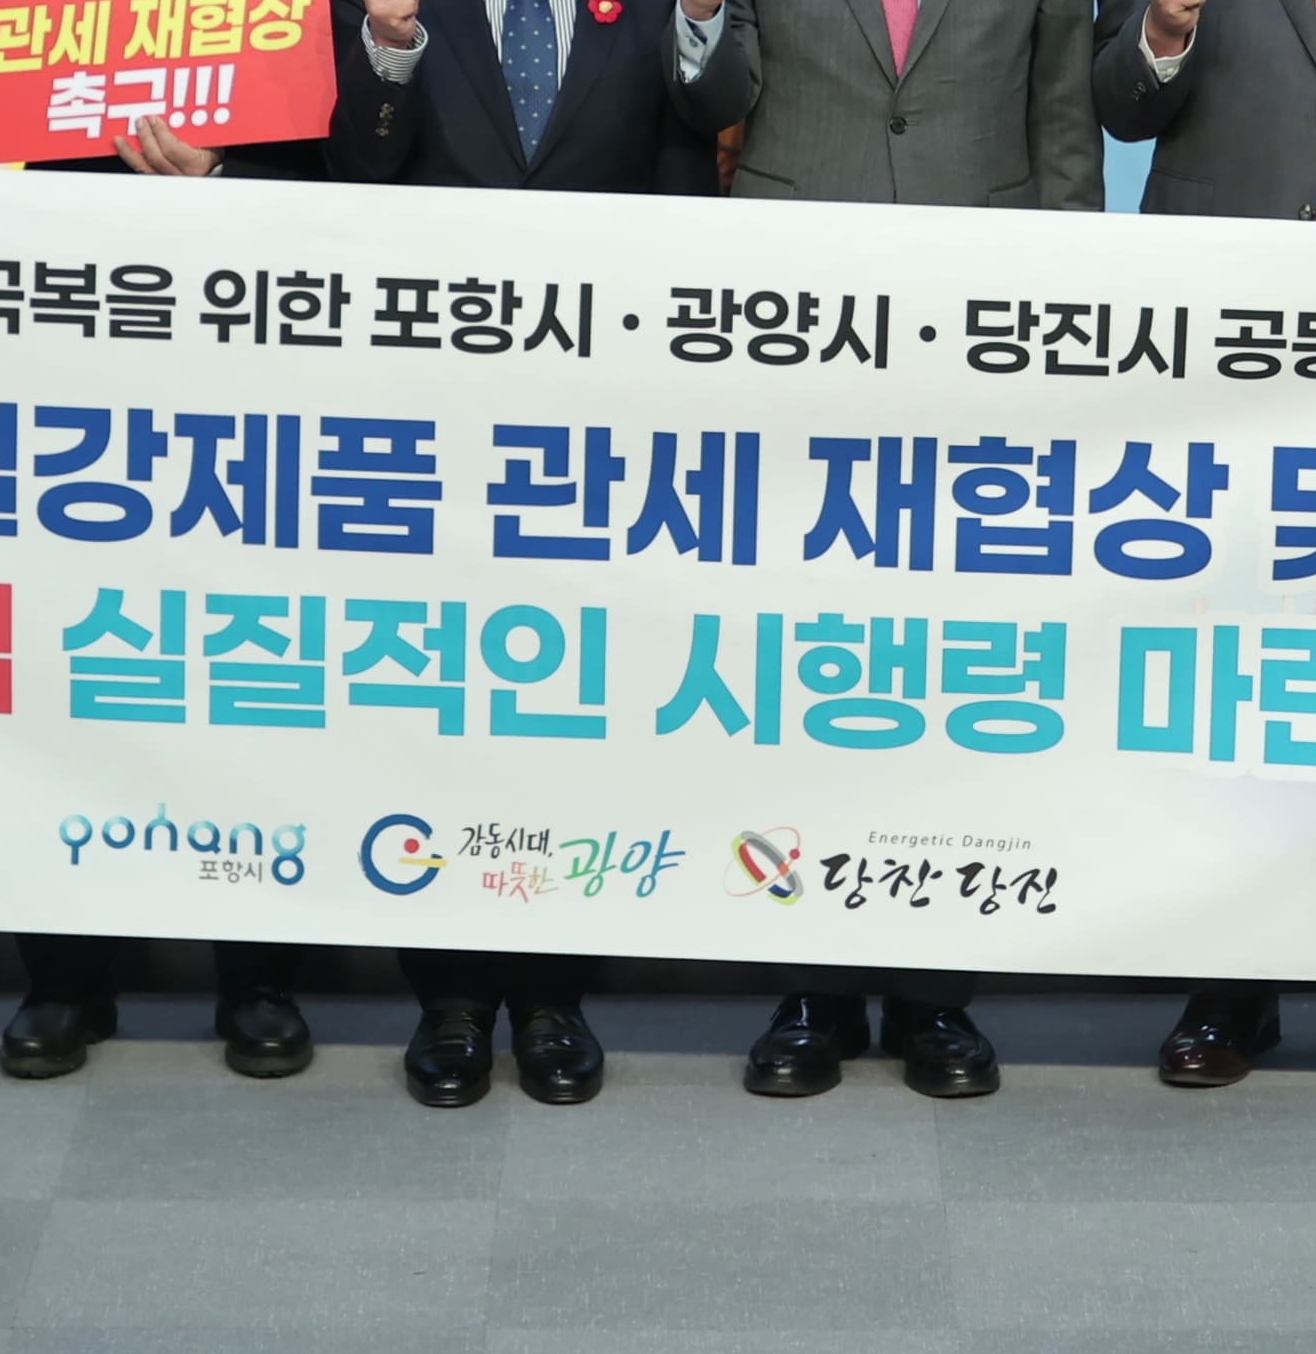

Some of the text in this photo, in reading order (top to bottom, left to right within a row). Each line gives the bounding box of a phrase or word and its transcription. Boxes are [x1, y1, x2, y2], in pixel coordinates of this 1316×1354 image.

[46, 63, 236, 138] 촉구!!!
[199, 269, 351, 348] 위한
[486, 424, 760, 566] 관세
[802, 435, 1230, 584] 재협상
[61, 586, 607, 741] 실질적인
[655, 611, 1068, 755] 시행령
[198, 859, 264, 883] 포항시
[457, 822, 553, 859] 감동시대,
[481, 830, 686, 903] 따뜻한 광양
[868, 831, 1033, 852] Energetic Dangjin
[819, 853, 1059, 916] 당찬 당진
